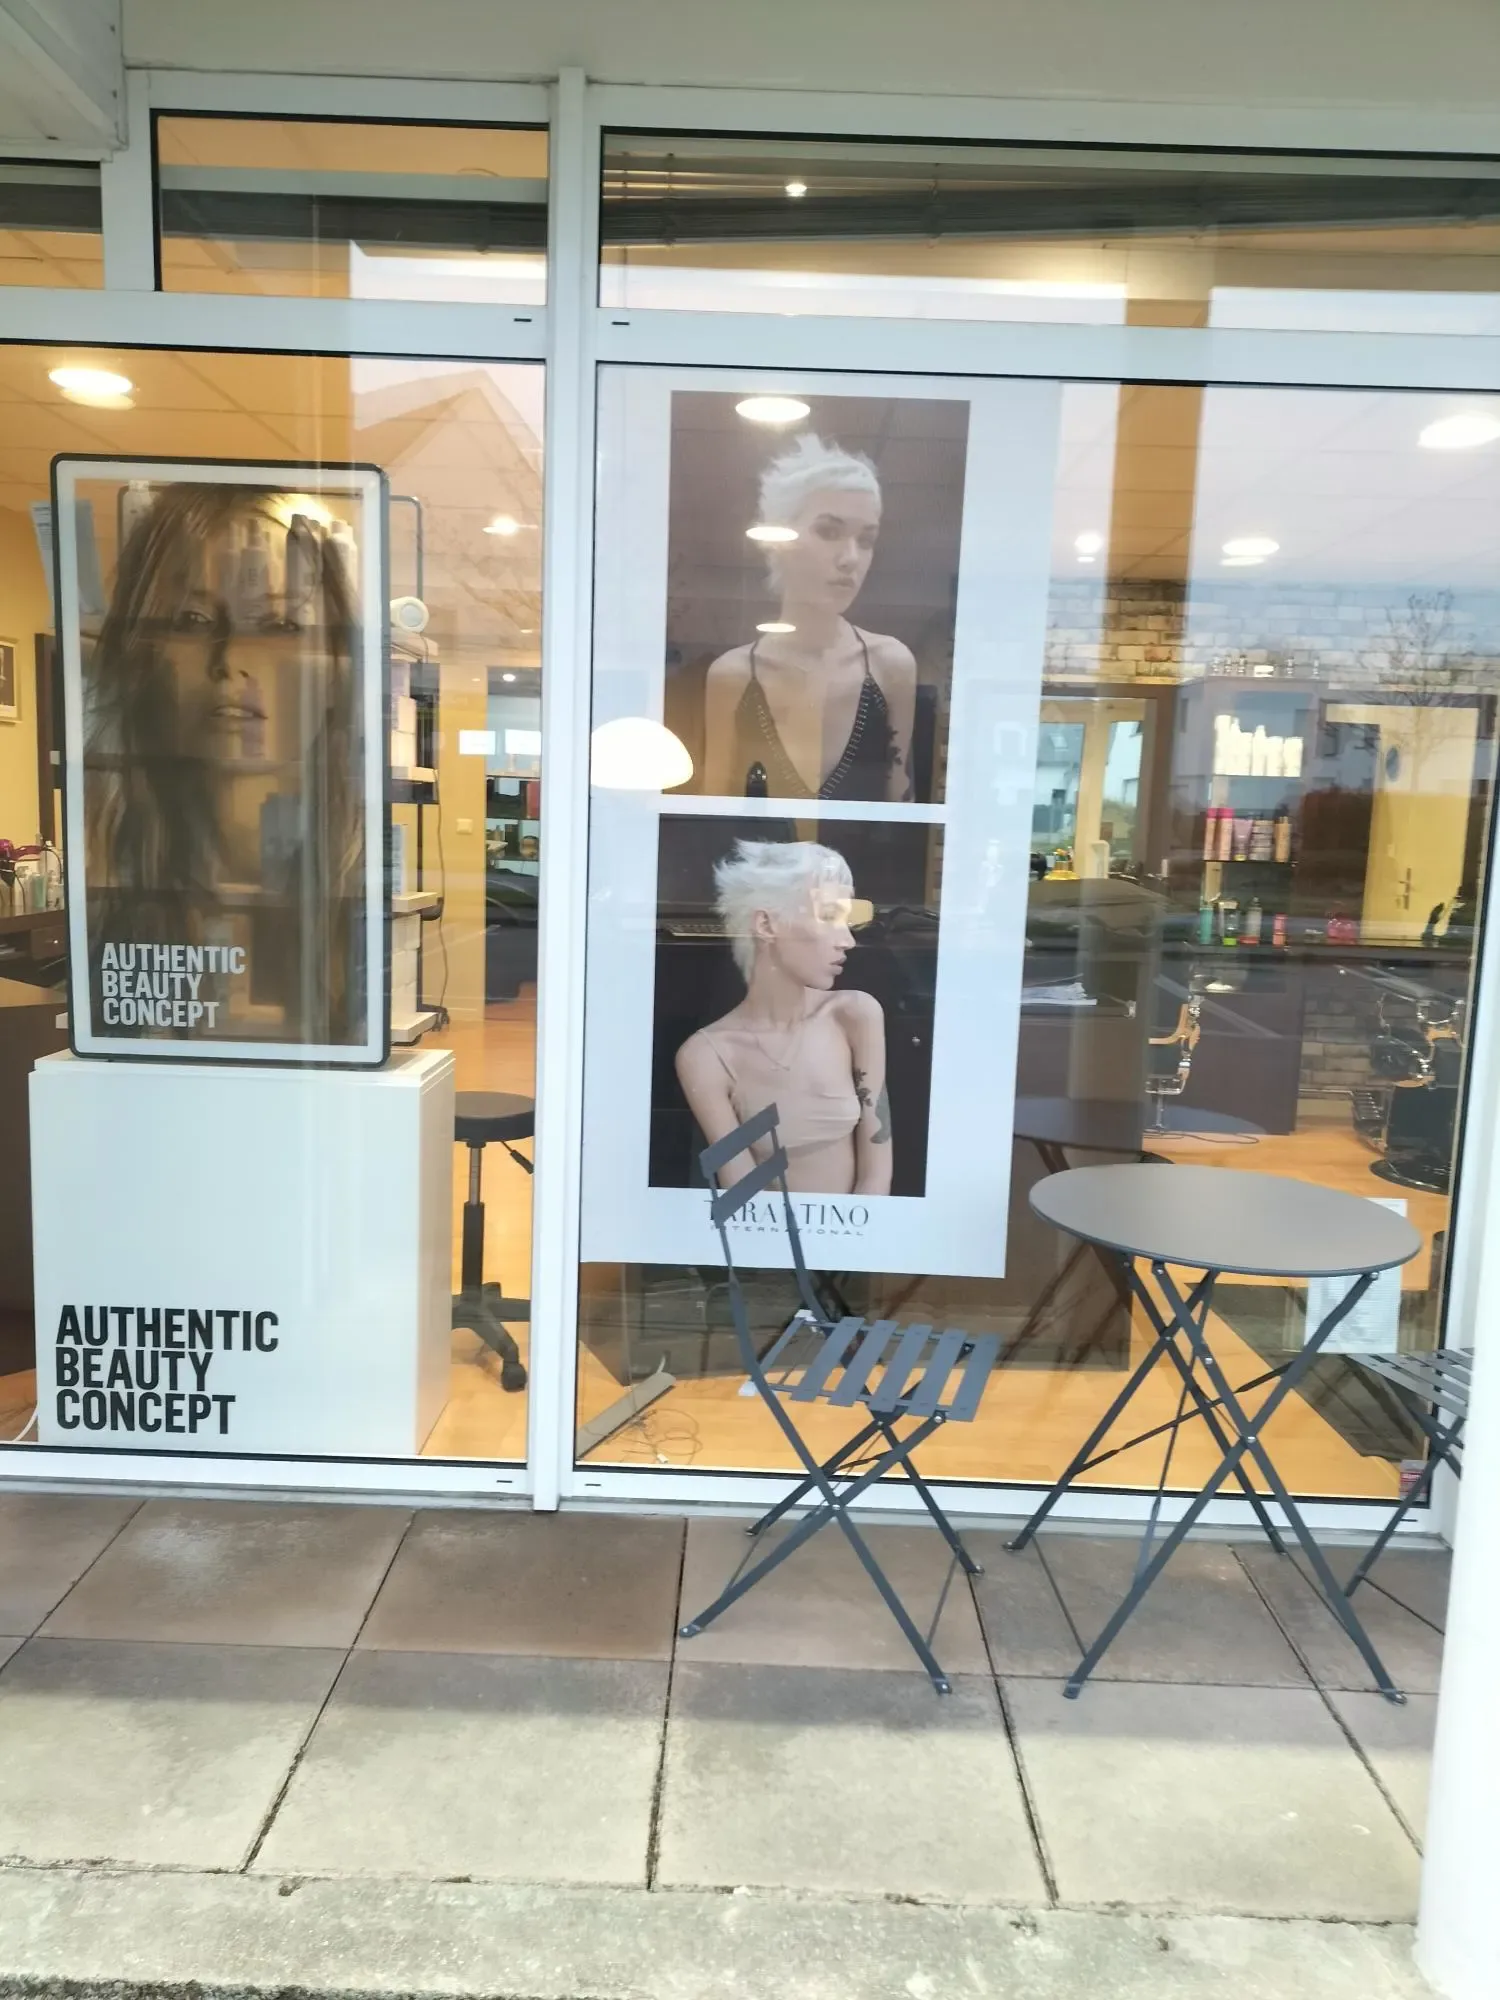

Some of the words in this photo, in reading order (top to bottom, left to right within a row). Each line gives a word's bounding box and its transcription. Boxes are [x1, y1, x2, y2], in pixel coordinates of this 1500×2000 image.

[101, 942, 246, 974] AUTHENTIC
[102, 970, 203, 1000] BEAUTY
[103, 998, 220, 1028] CONCEPT
[703, 1200, 869, 1228] RATINO
[710, 1225, 865, 1236] ITERNIONAL
[56, 1304, 279, 1352] AUTHENTIC
[56, 1346, 213, 1391] BEAUTY
[56, 1388, 236, 1434] CONCEPT
